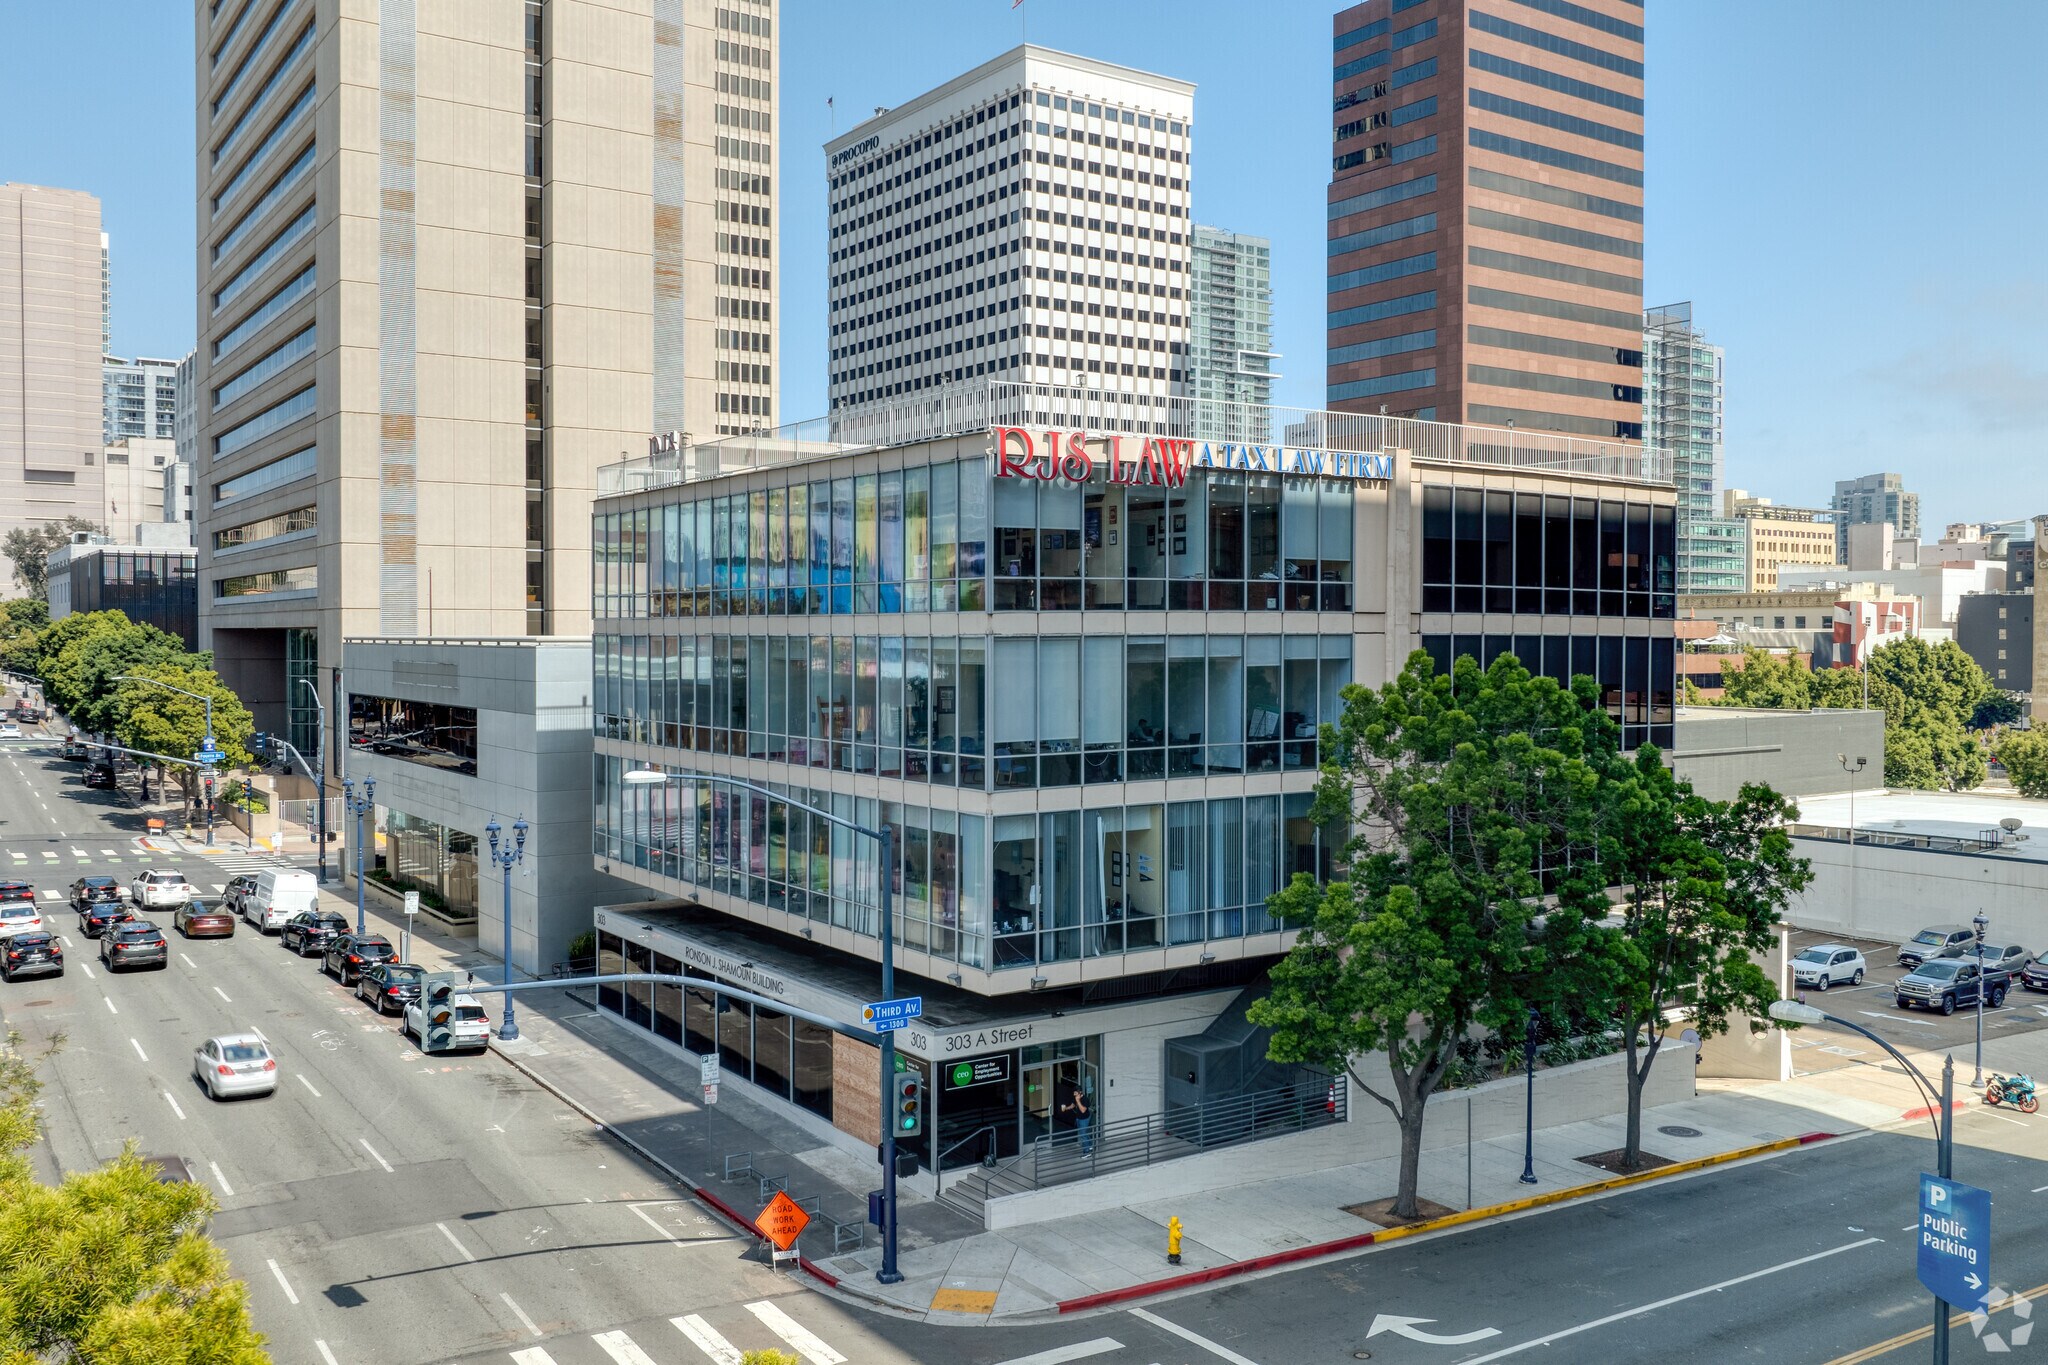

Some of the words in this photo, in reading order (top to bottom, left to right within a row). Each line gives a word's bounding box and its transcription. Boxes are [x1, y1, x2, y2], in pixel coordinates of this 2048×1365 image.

[838, 135, 880, 165] PROCOPIO
[995, 427, 1093, 482] RJS
[1108, 436, 1196, 488] LAW
[1198, 443, 1214, 468] A
[1221, 444, 1268, 471] TAX
[1276, 446, 1328, 475] LAW
[1335, 453, 1393, 479] FIRM
[597, 913, 606, 926] 303
[685, 946, 712, 967] RONSON
[719, 959, 752, 981] SHAMOUN
[752, 971, 784, 995] BUILDING
[889, 1020, 905, 1029] 1300
[911, 1032, 926, 1051] 303
[945, 1034, 972, 1052] 303
[976, 1033, 987, 1047] A
[991, 1024, 1033, 1045] Street
[957, 1071, 970, 1079] ceo
[974, 1066, 1000, 1075] Employment
[974, 1071, 1002, 1080] Opportunities
[1930, 1184, 1947, 1206] P
[772, 1205, 793, 1213] ROAD
[773, 1215, 794, 1224] WORK
[1924, 1213, 1967, 1240] Public
[772, 1226, 797, 1235] AHEAD
[1923, 1231, 1977, 1265] Parking
